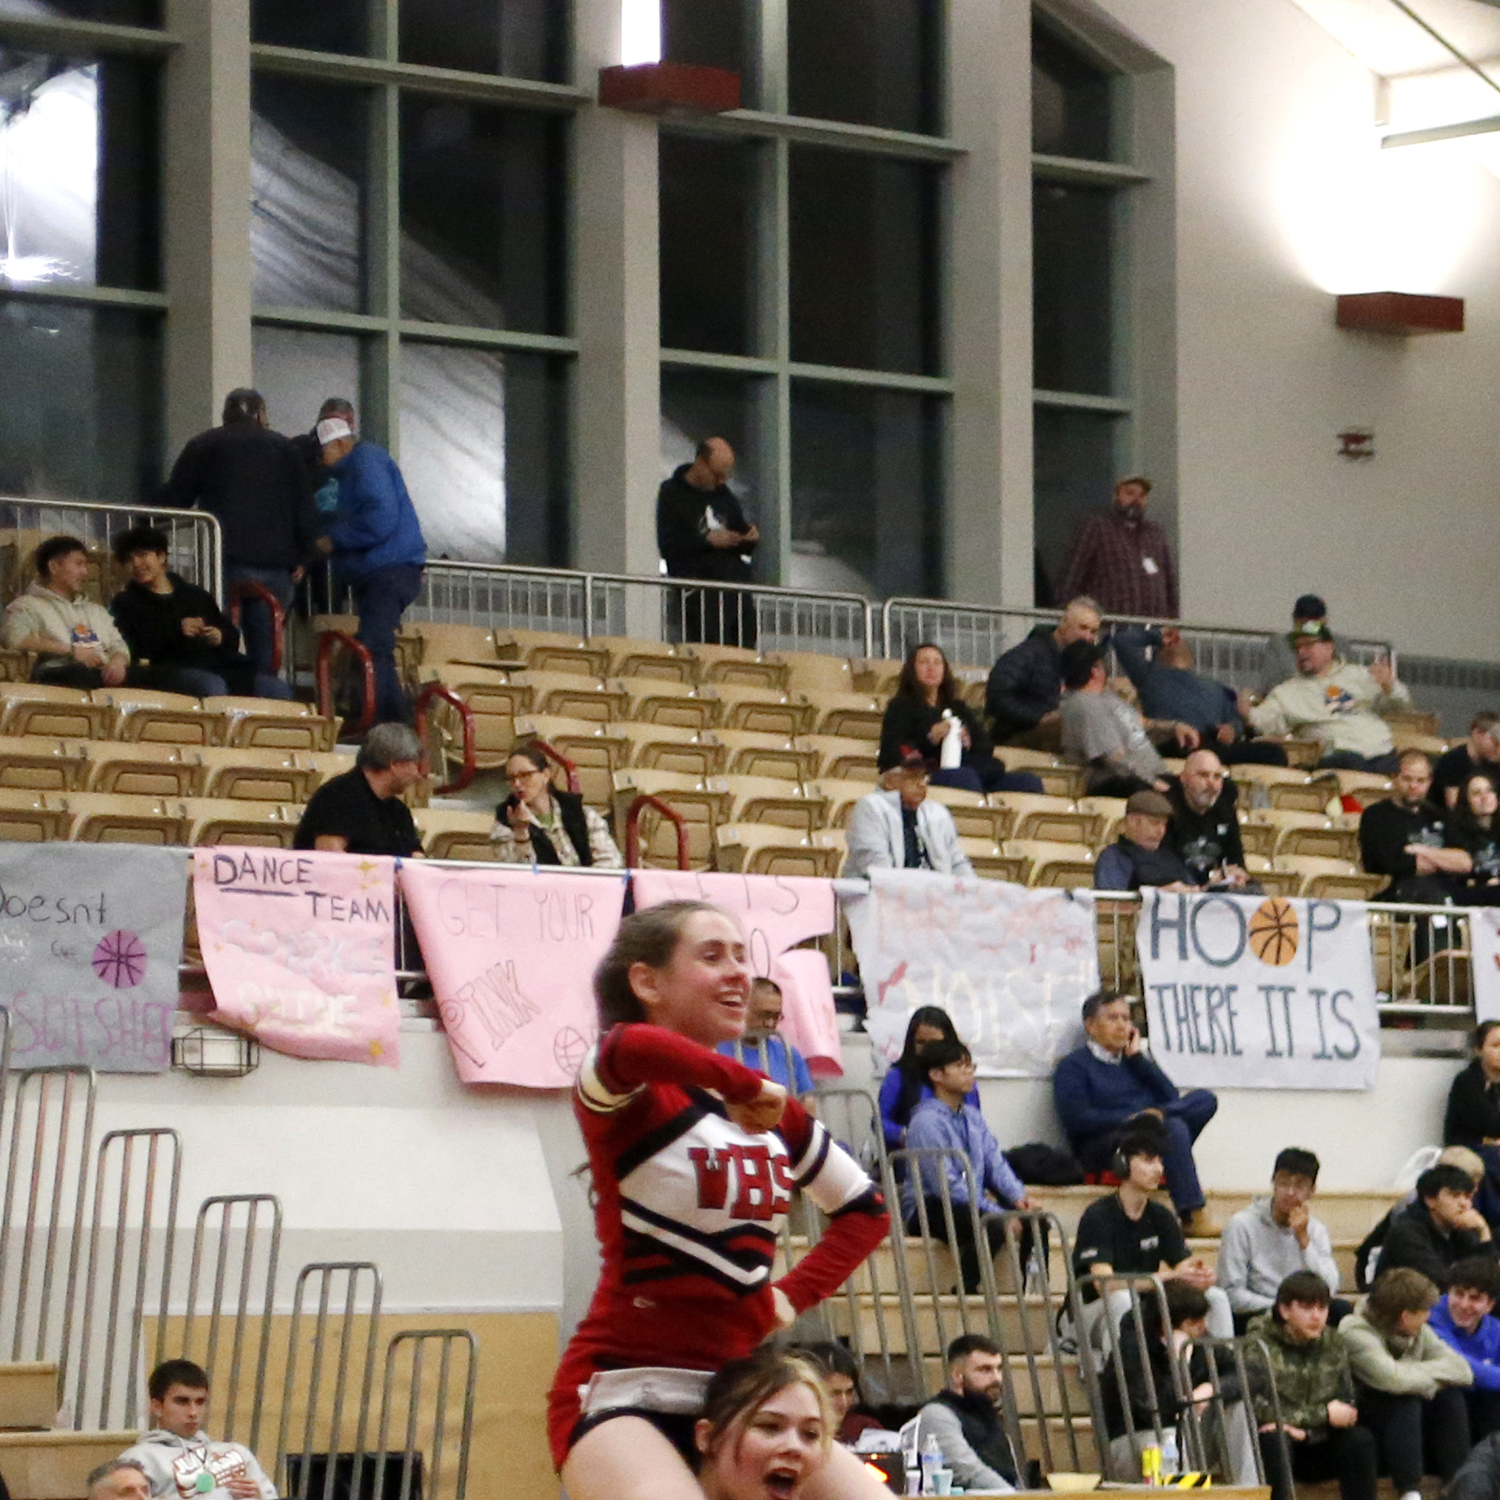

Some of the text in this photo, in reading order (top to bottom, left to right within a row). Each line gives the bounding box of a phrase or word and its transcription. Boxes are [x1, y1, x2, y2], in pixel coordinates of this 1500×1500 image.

[212, 851, 314, 886] DANCE
[305, 891, 391, 924] TEAM
[437, 879, 595, 942] GET YOUR
[1149, 984, 1362, 1060] THERE IT IS
[688, 1142, 794, 1221] WHS
